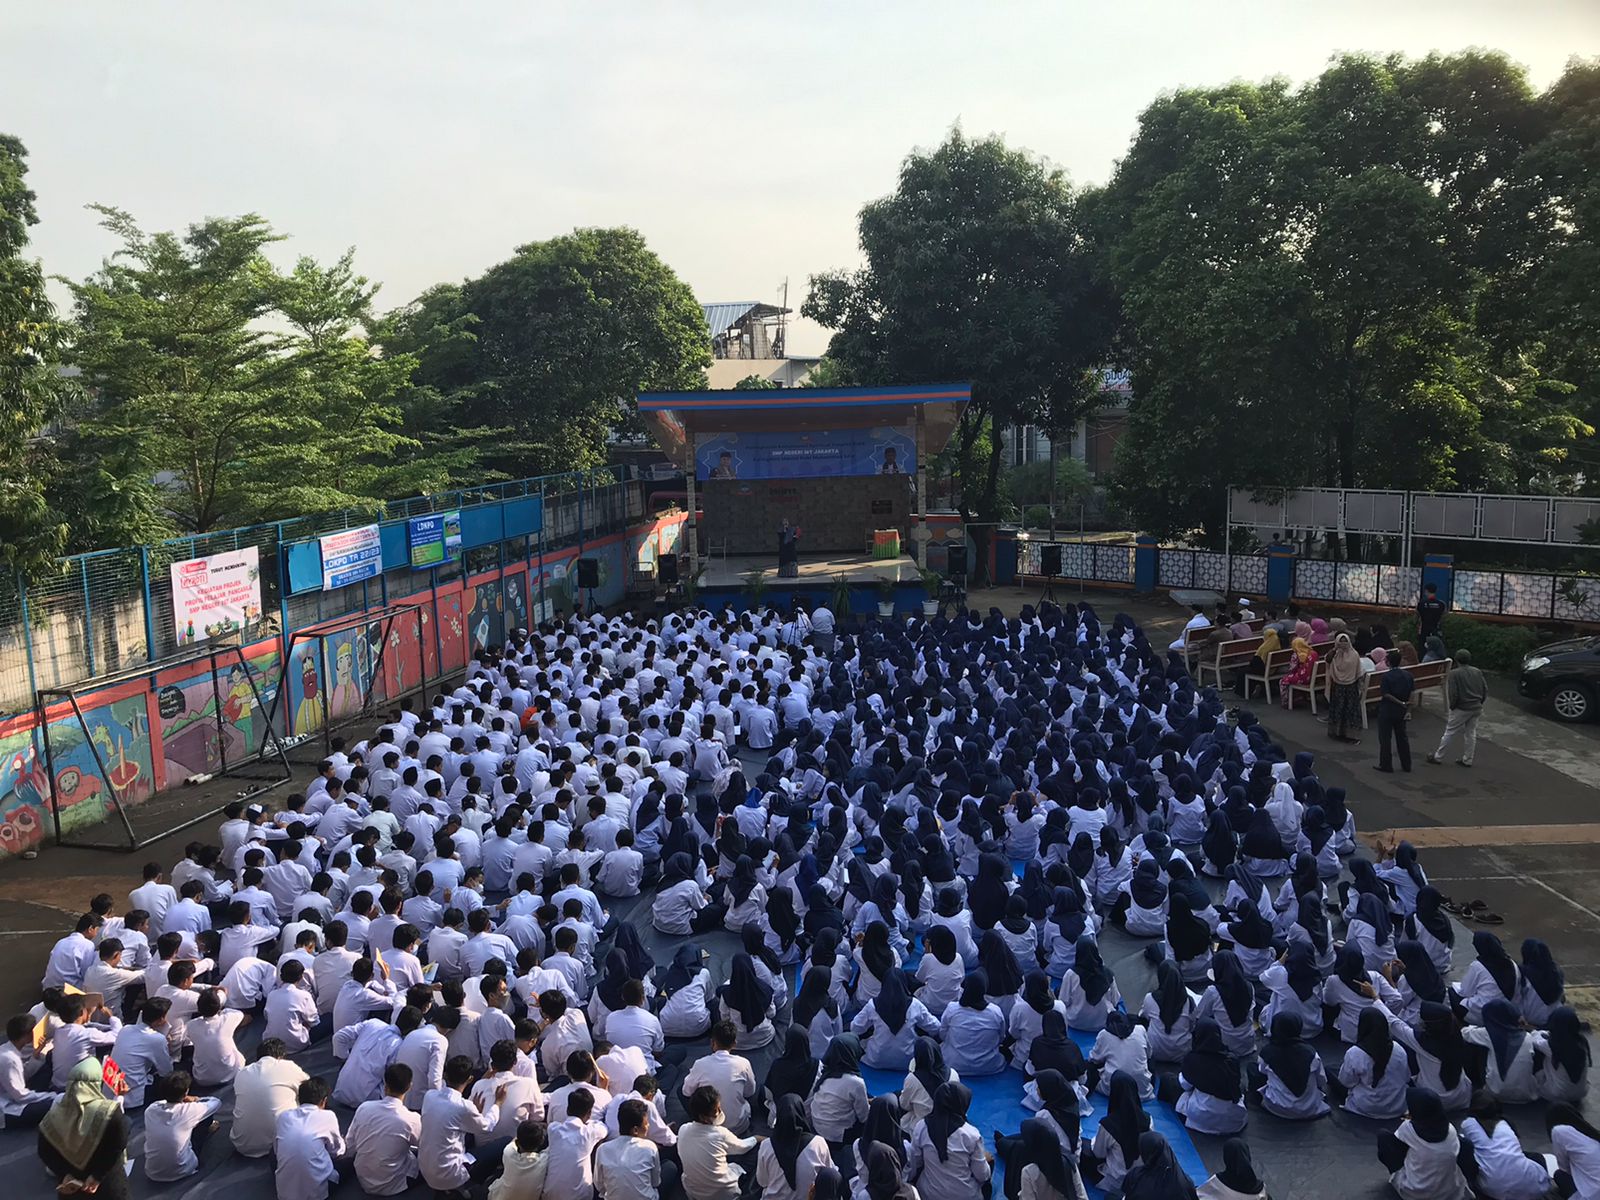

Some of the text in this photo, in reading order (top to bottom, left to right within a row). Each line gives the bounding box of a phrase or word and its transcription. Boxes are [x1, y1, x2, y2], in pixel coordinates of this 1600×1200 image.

[349, 553, 359, 562] TA
[211, 566, 224, 574] TURUT
[223, 580, 242, 589] PROJEK
[189, 606, 200, 614] SMP
[230, 593, 250, 604] JAKARTA
